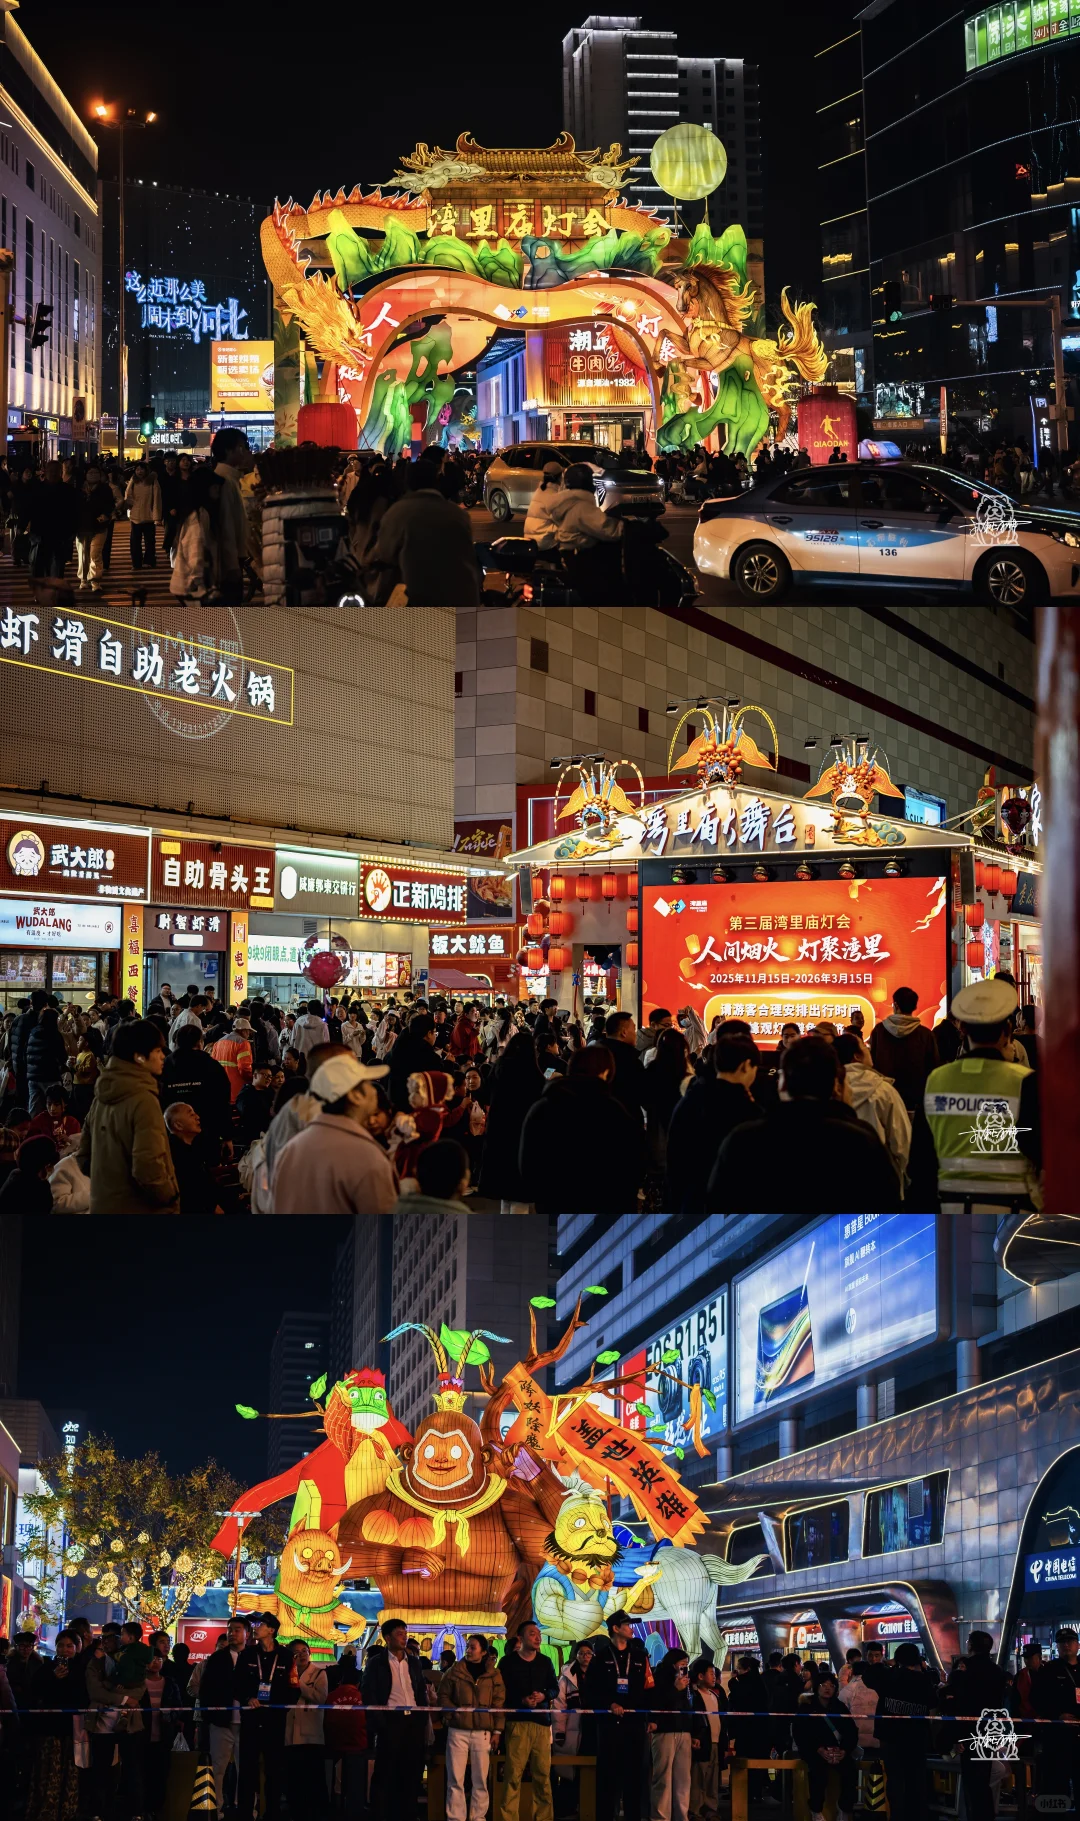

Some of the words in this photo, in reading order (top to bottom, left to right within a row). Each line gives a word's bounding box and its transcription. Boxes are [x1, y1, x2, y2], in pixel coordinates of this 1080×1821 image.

[427, 203, 613, 238] 湾里庙灯会
[125, 270, 207, 304] 这么近那么美
[141, 297, 249, 343] 周末到河北
[813, 439, 849, 448] QIAODAN
[805, 534, 839, 542] 95128
[879, 548, 897, 556] 136
[0, 607, 275, 712] 虾滑自助老火锅
[639, 798, 797, 856] 湾里庙大舞台
[51, 844, 105, 870] 武大郎
[163, 856, 272, 895] 自助骨头王
[393, 880, 463, 912] 正新鸡排
[32, 906, 56, 916] 武大郎
[729, 914, 851, 931] 第三届湾里庙灯会
[15, 915, 72, 933] WUDALANG
[428, 934, 505, 955] 板大鱿鱼
[690, 936, 791, 965] 人间烟火
[794, 933, 891, 964] 灯聚湾里
[709, 972, 873, 985] 2025年11月15日-2026年3月15日
[720, 1003, 862, 1018] 请游客合理安排出行时间
[844, 1215, 864, 1240] 惠普星
[518, 1379, 545, 1451] 降妖除魔
[1044, 1556, 1076, 1575] 中国电信
[877, 1621, 903, 1635] Canon
